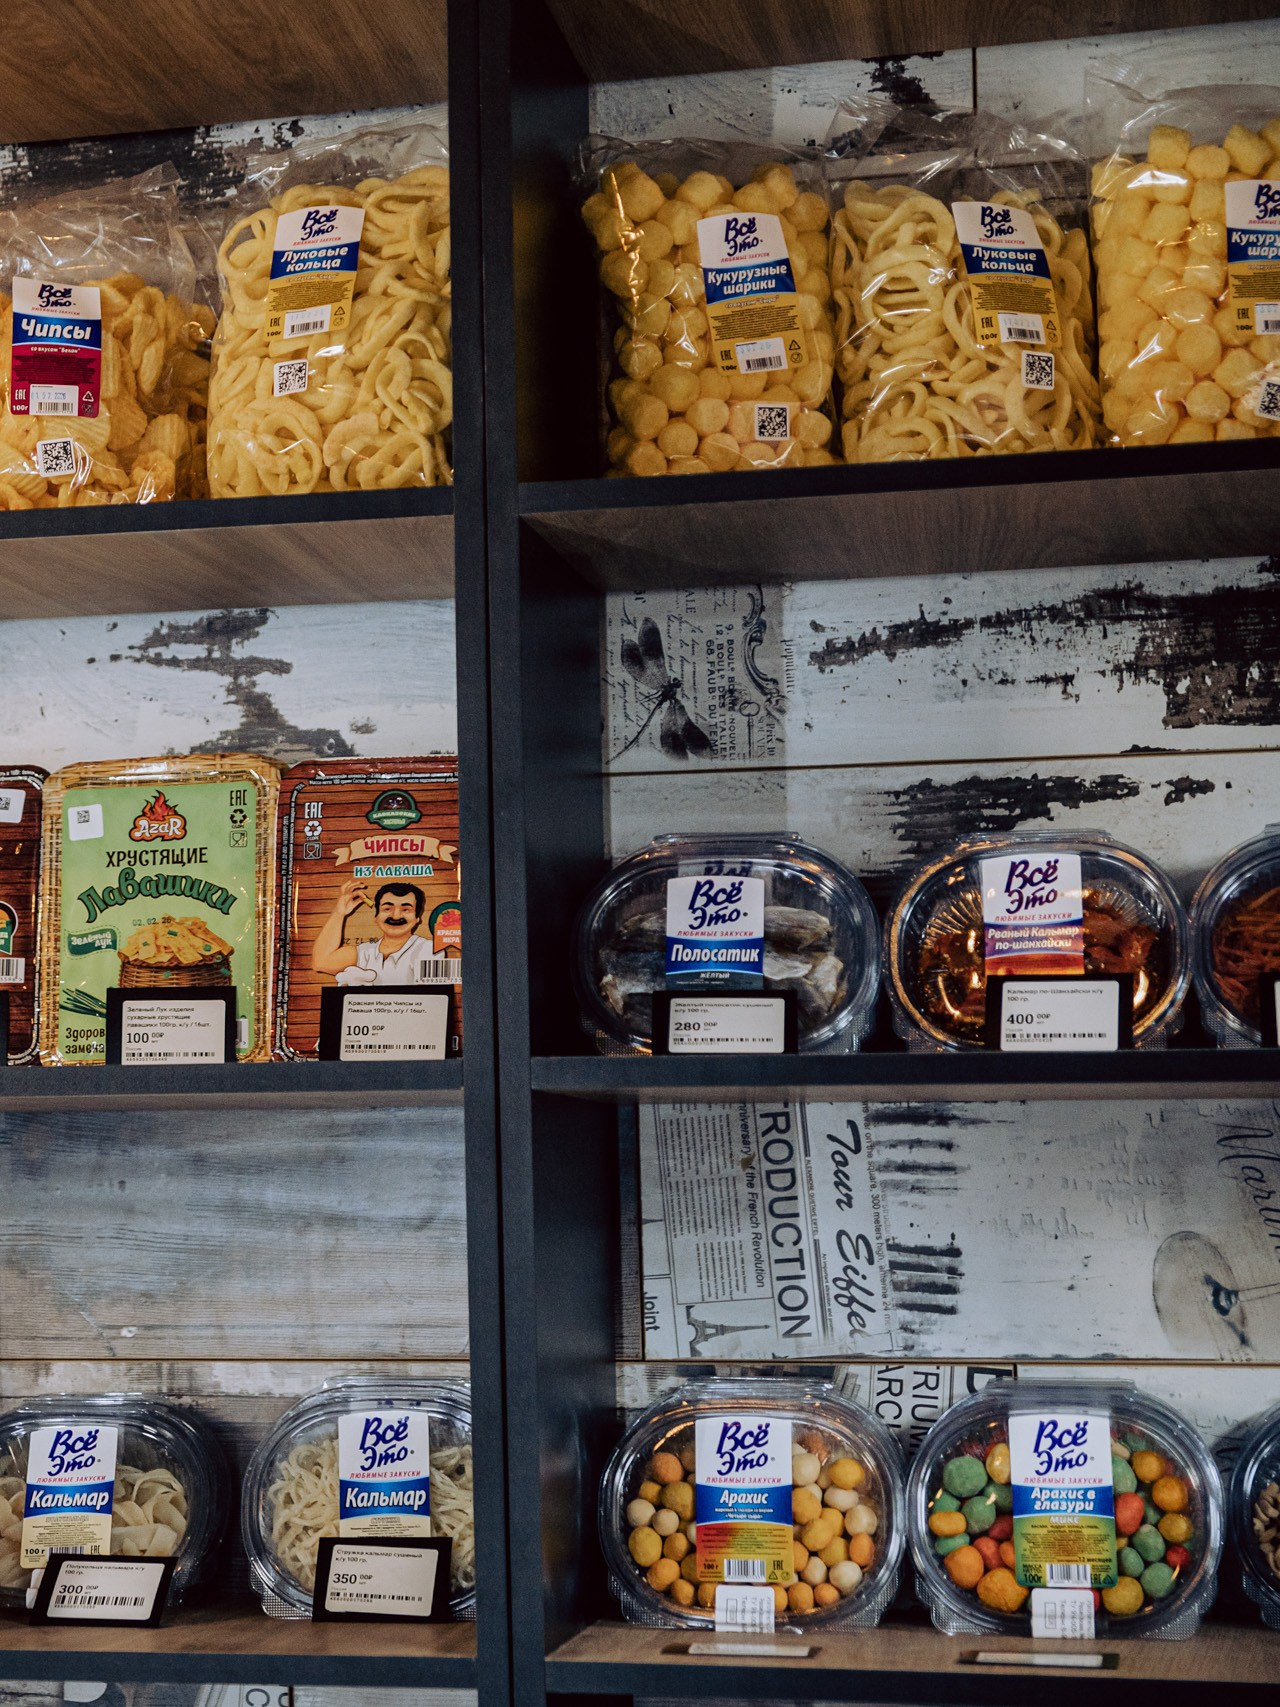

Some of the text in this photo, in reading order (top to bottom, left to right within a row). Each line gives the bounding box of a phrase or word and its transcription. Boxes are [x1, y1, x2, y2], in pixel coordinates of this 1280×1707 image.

[302, 208, 339, 229] Всё
[981, 206, 1011, 225] Всё
[301, 225, 335, 240] Это
[725, 217, 757, 242] Всё
[984, 223, 1014, 238] Это
[280, 247, 348, 263] Луковые
[727, 236, 759, 256] Это
[972, 247, 1036, 261] Луковые
[286, 258, 341, 272] кольца
[982, 260, 1034, 273] кольца
[708, 264, 787, 285] Кукурузные
[723, 279, 775, 296] шарики
[21, 319, 92, 341] Чипсы
[135, 819, 182, 837] AzaR
[364, 838, 425, 854] ЧИПСЫ
[106, 847, 208, 867] ХРУСТЯЩИЕ
[376, 864, 433, 877] ЛАВАША
[1004, 859, 1059, 893] Всё
[77, 867, 238, 923] Лавашики
[688, 880, 744, 910] Всё
[1006, 888, 1058, 914] Это
[688, 906, 741, 930] Это
[994, 914, 1035, 922] ЛЮБИМЫЕ
[71, 932, 111, 945] Зелёный
[988, 926, 1079, 939] Рваный Кальмар
[995, 937, 1072, 950] по-шанхайски
[671, 944, 760, 963] Полосатик
[674, 1022, 701, 1031] 280
[1007, 1014, 1034, 1024] 400
[126, 1033, 149, 1043] 100
[346, 1026, 369, 1036] 100
[871, 1193, 881, 1209] 300
[745, 1172, 765, 1288] the French Revolution
[759, 1103, 812, 1340] RODUCTION
[644, 1291, 660, 1332] Joint
[359, 1416, 409, 1450] Всё
[716, 1421, 770, 1455] Всё
[1033, 1420, 1089, 1453] Всё
[48, 1429, 99, 1459] Всё
[47, 1453, 95, 1477] Это
[360, 1446, 408, 1472] Это
[716, 1450, 768, 1476] Это
[1035, 1449, 1088, 1476] Это
[76, 1475, 106, 1483] ЗАКУСКИ
[389, 1470, 421, 1478] ЗАКУСКИ
[706, 1476, 782, 1484] ЛЮБИМЫЕ ЗАКУСКИ
[29, 1490, 110, 1510] Кальмар
[345, 1487, 427, 1510] Кальмар
[720, 1489, 769, 1507] Арахис
[1031, 1487, 1095, 1501] Арахис в
[1034, 1501, 1094, 1513] глазури
[333, 1573, 357, 1584] 350
[58, 1584, 83, 1594] 300
